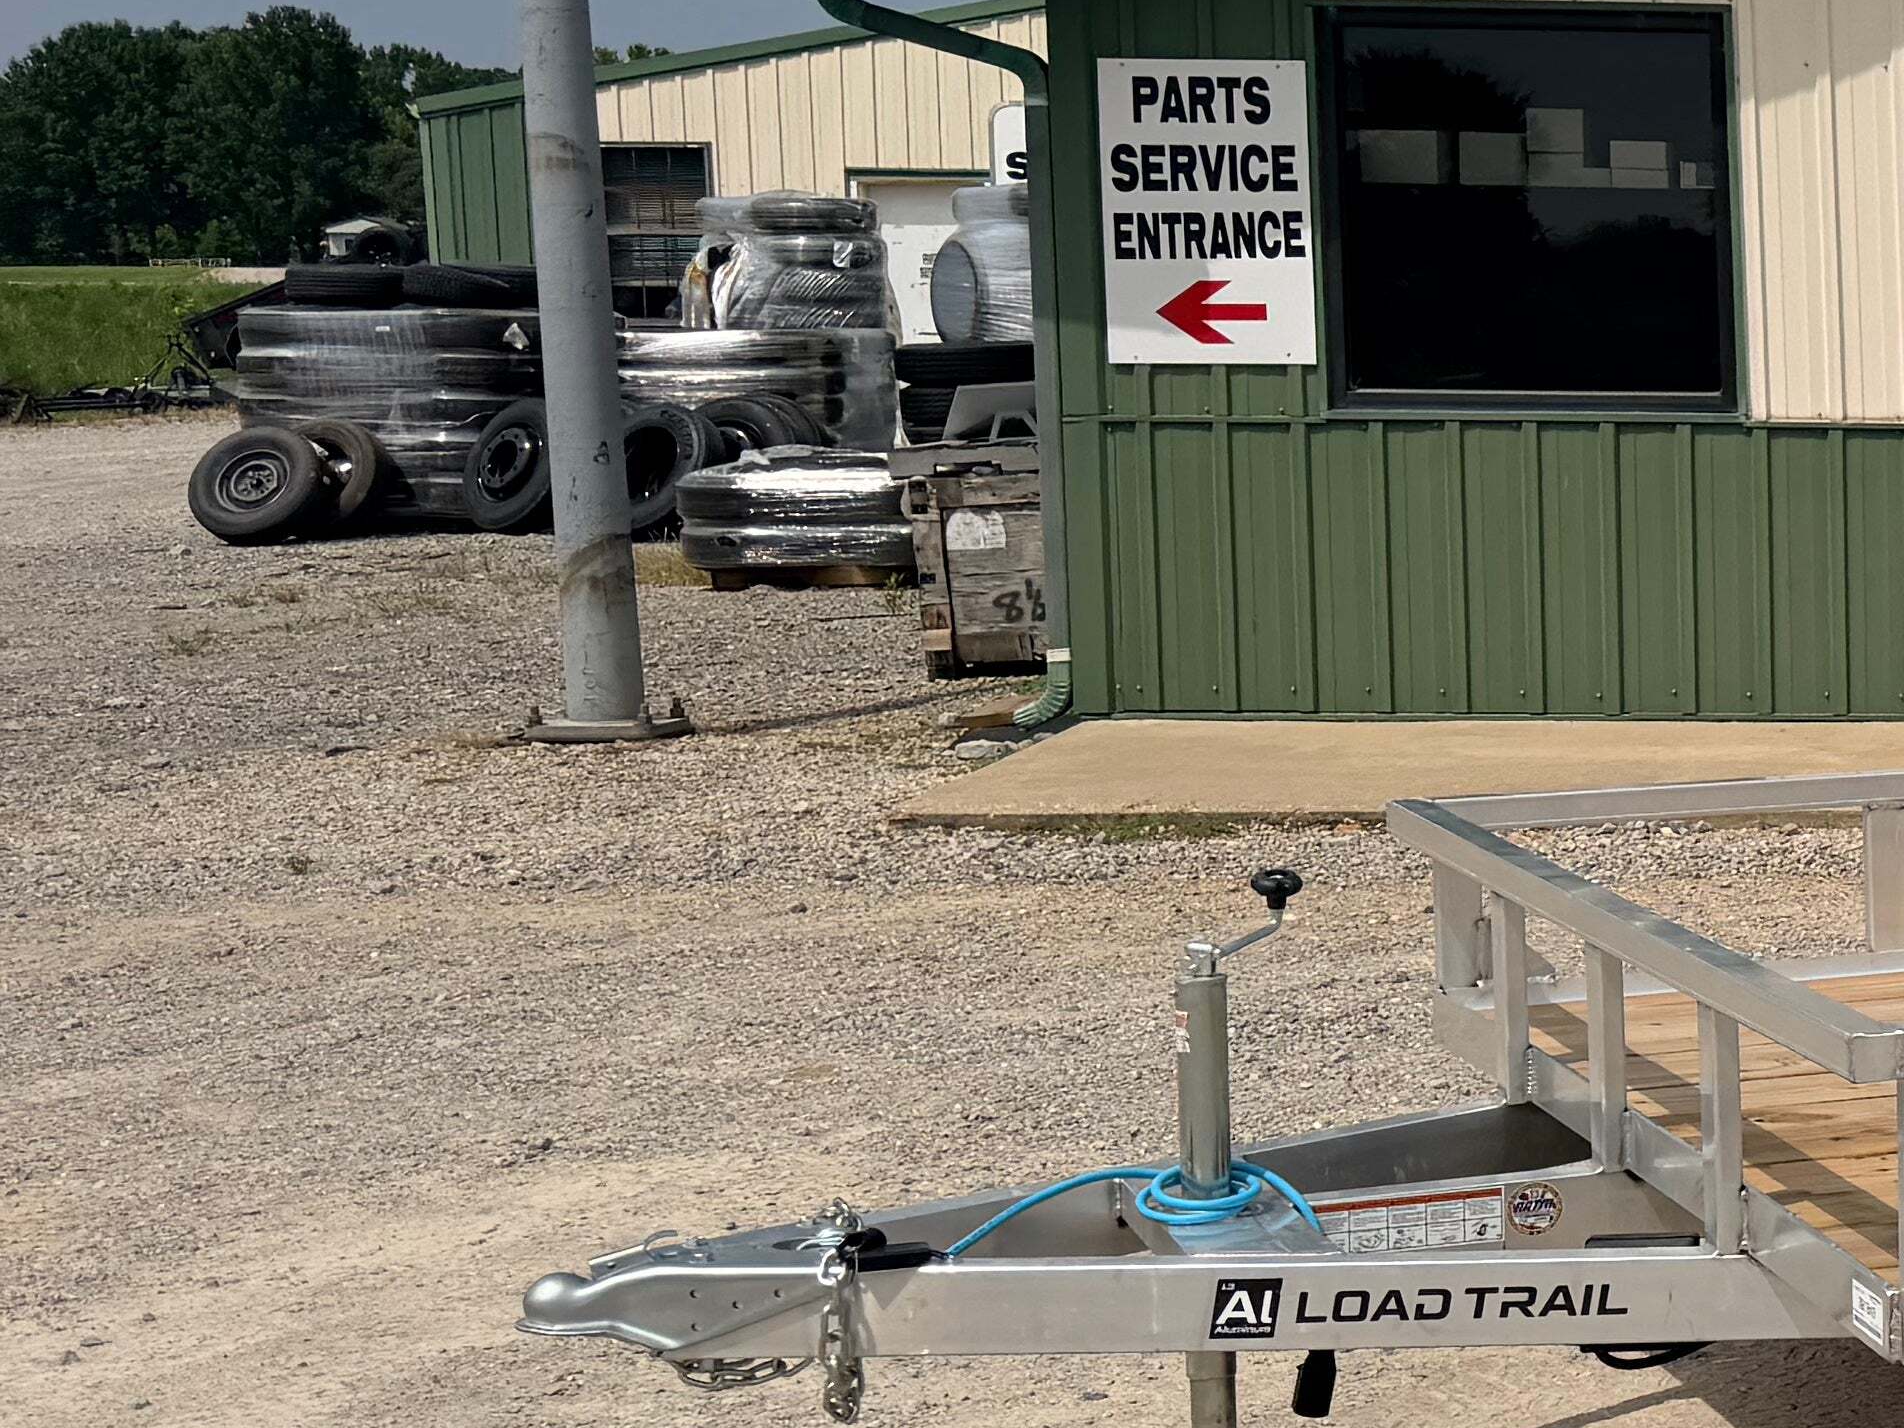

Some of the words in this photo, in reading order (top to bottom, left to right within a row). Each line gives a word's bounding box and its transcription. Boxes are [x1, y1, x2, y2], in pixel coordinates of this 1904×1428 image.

[1131, 75, 1271, 125] PARTS
[1110, 143, 1299, 193] SERVICE
[1112, 210, 1307, 260] ENTRANCE
[1295, 1288, 1452, 1323] LOAD
[1464, 1283, 1629, 1318] TRAIL
